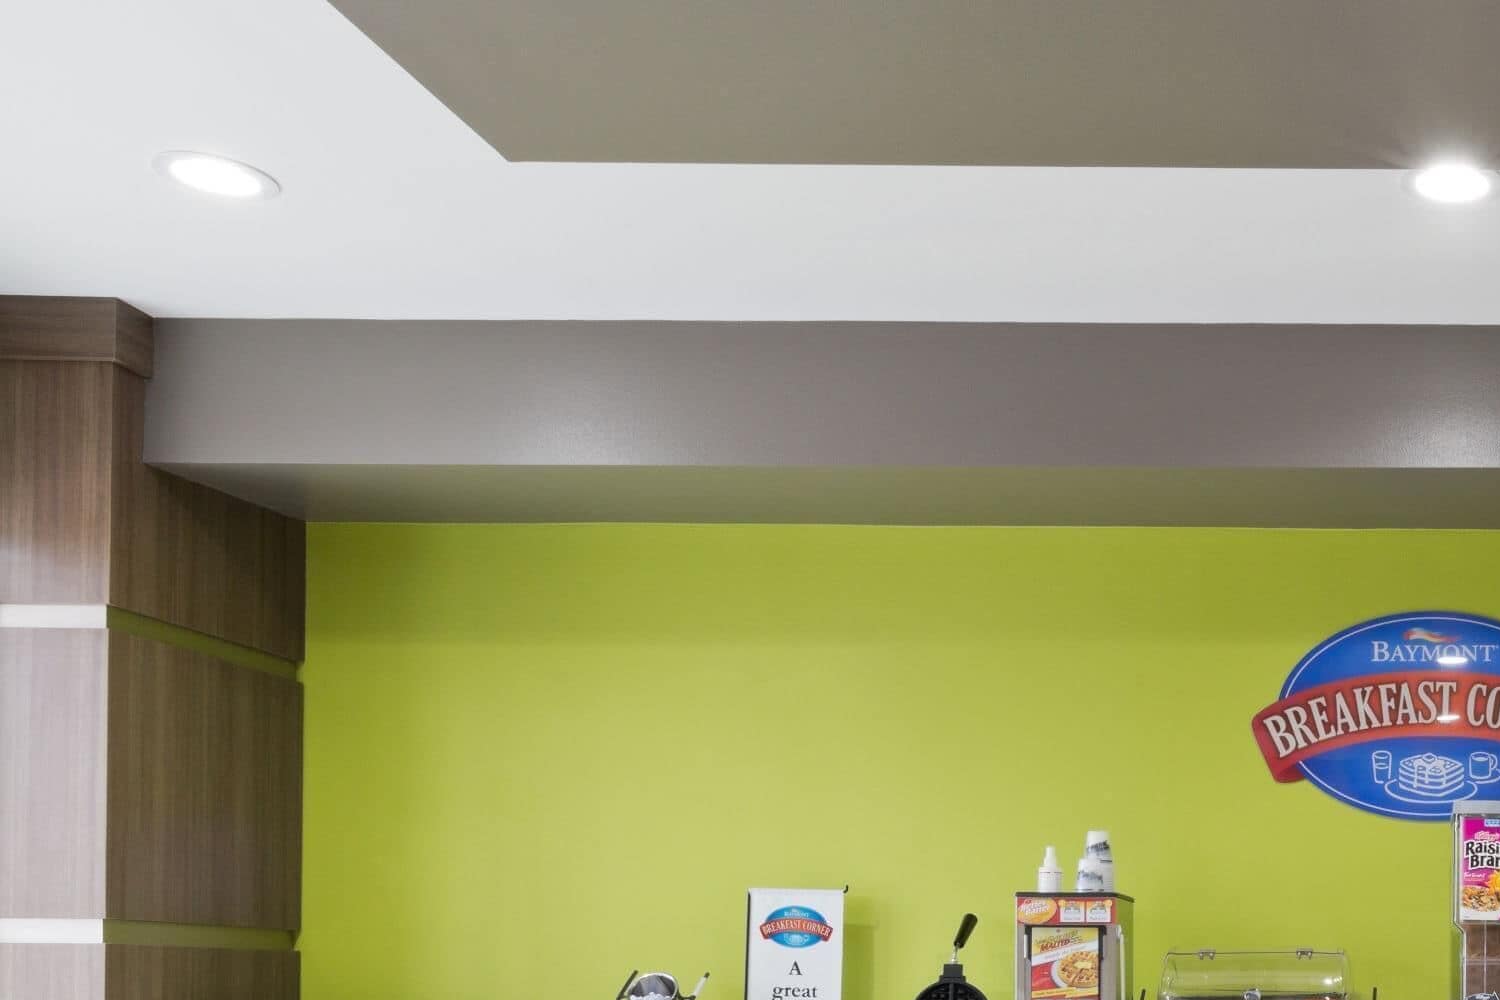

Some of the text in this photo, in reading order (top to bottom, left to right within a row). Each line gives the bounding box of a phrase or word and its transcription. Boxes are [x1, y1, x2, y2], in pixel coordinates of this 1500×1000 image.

[1371, 641, 1495, 663] BAYMONT
[1263, 681, 1456, 758] BREAKFAST
[761, 919, 831, 937] BREAKFAST CORNER
[788, 960, 803, 976] A
